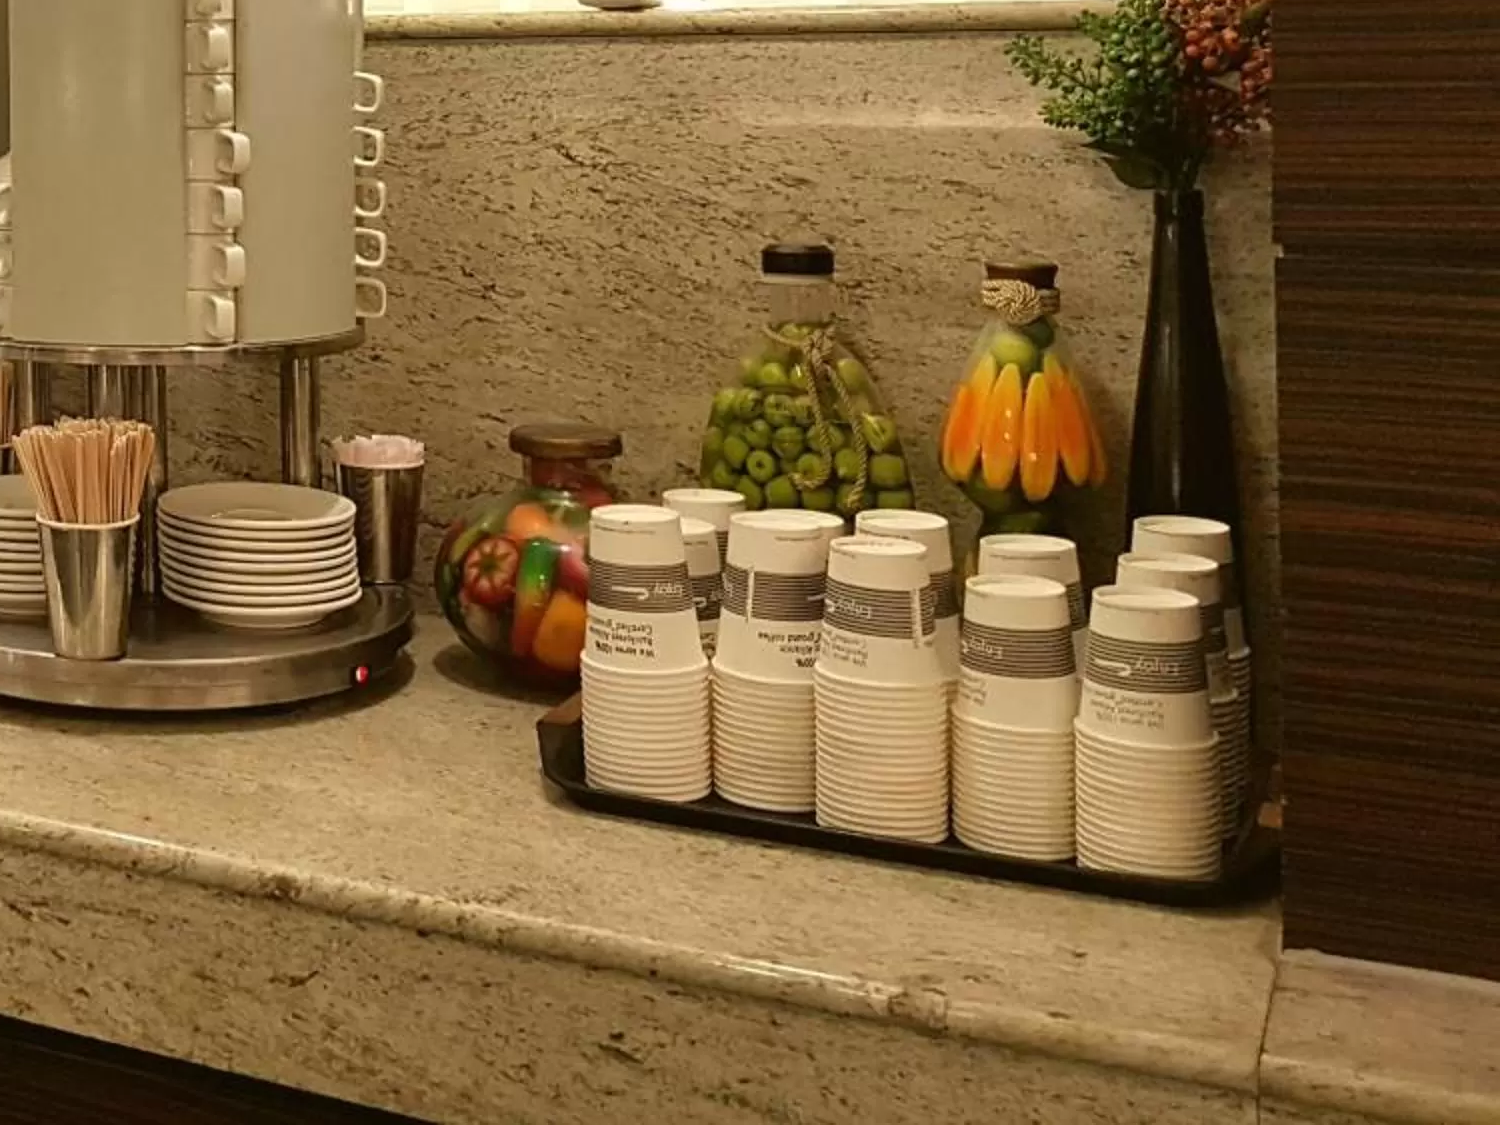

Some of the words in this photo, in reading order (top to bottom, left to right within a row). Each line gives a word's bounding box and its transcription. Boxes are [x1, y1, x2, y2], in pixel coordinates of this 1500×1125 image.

[653, 583, 684, 597] Enjoy
[615, 646, 637, 655] serve
[639, 648, 655, 658] We
[1135, 657, 1180, 676] Enjoy
